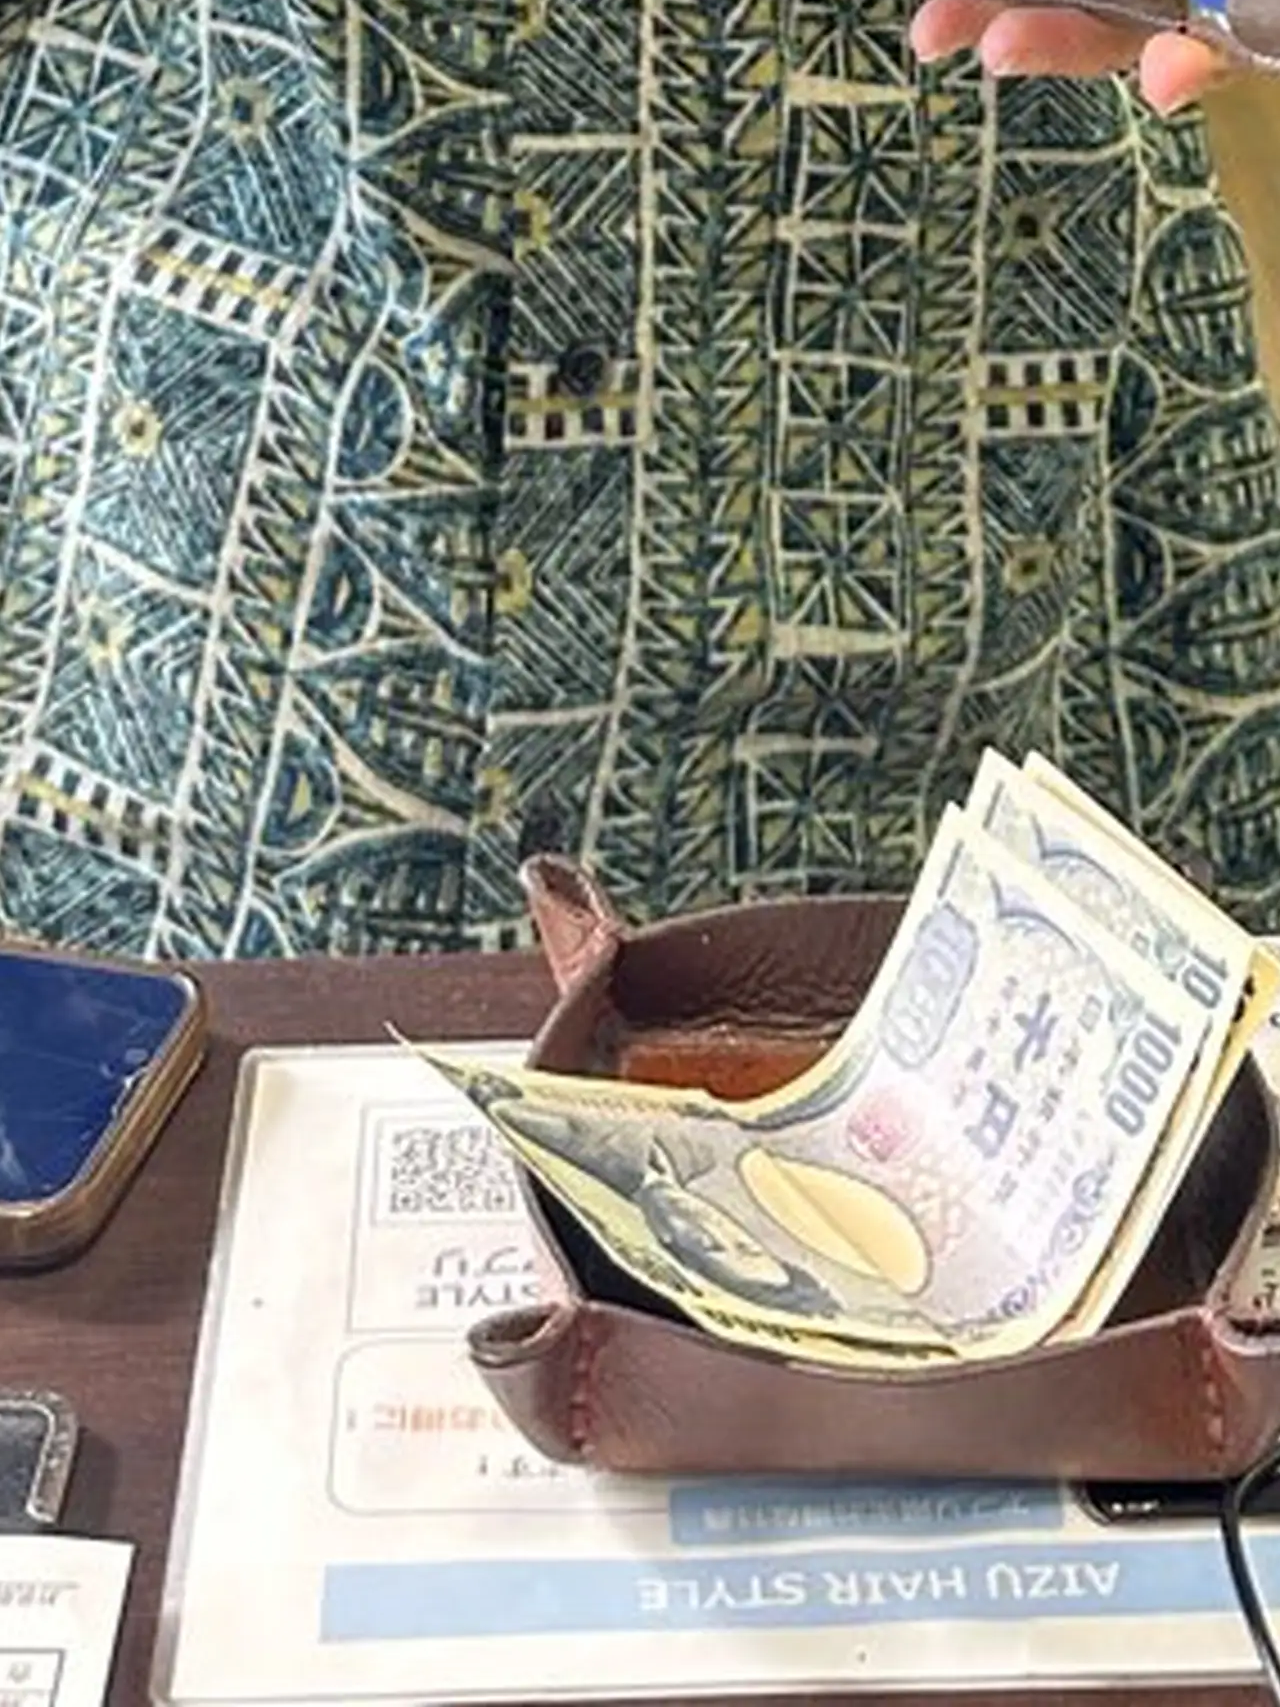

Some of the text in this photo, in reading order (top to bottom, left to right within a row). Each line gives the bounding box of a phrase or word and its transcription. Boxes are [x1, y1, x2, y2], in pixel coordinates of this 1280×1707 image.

[963, 991, 1059, 1160] 千円
[1105, 1011, 1183, 1139] 1000
[433, 1246, 534, 1277] プリ
[637, 1560, 1121, 1611] AIZU HAIR STYLE
